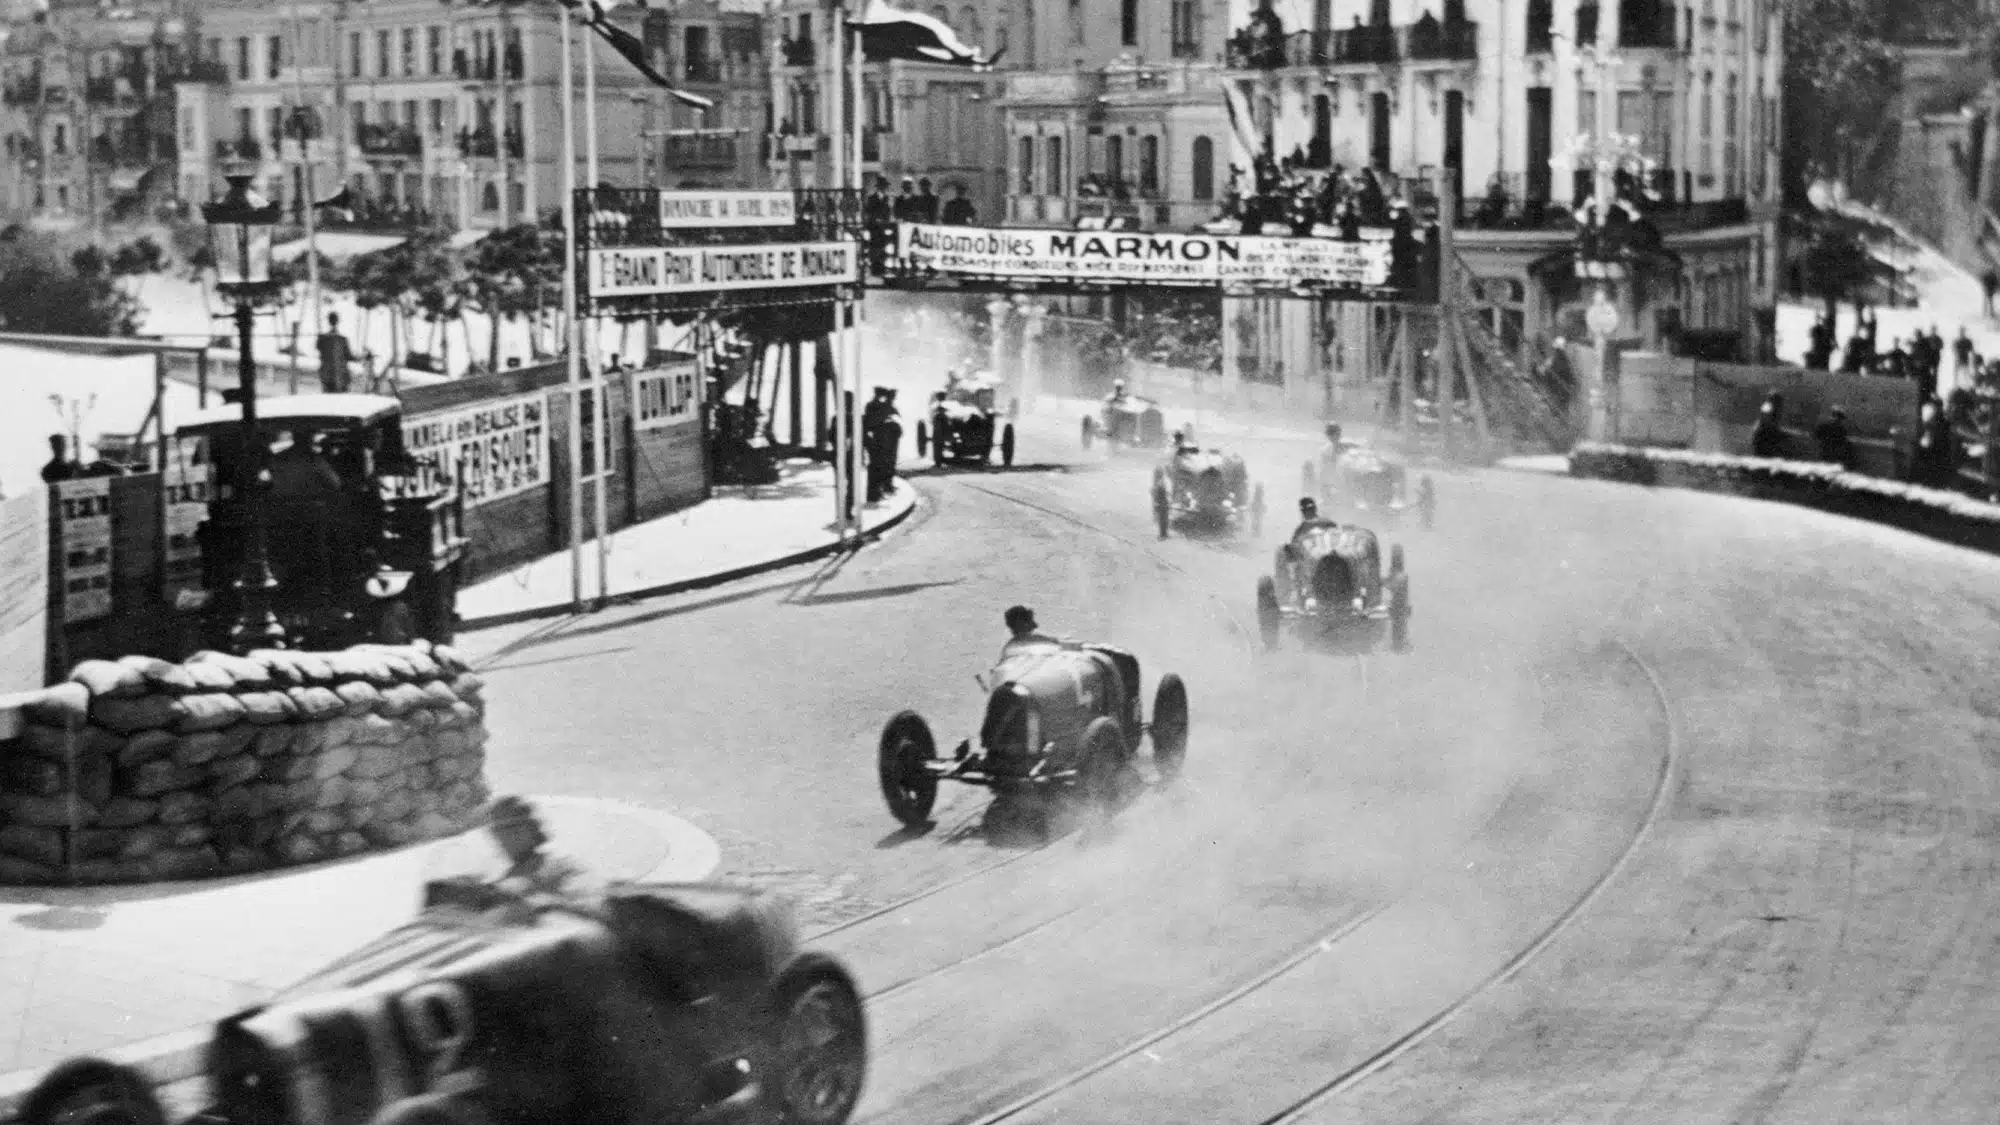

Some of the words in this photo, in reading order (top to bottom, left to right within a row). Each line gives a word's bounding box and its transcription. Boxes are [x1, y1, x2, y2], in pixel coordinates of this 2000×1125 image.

[908, 225, 1035, 257] Automobiles
[1049, 234, 1240, 261] MARMON
[614, 251, 658, 287] GRAND
[664, 249, 694, 285] PRIX
[702, 247, 775, 282] AUTOMOBILE
[781, 250, 796, 279] DE
[800, 246, 846, 276] MONACO
[640, 373, 693, 421] DUNLOP
